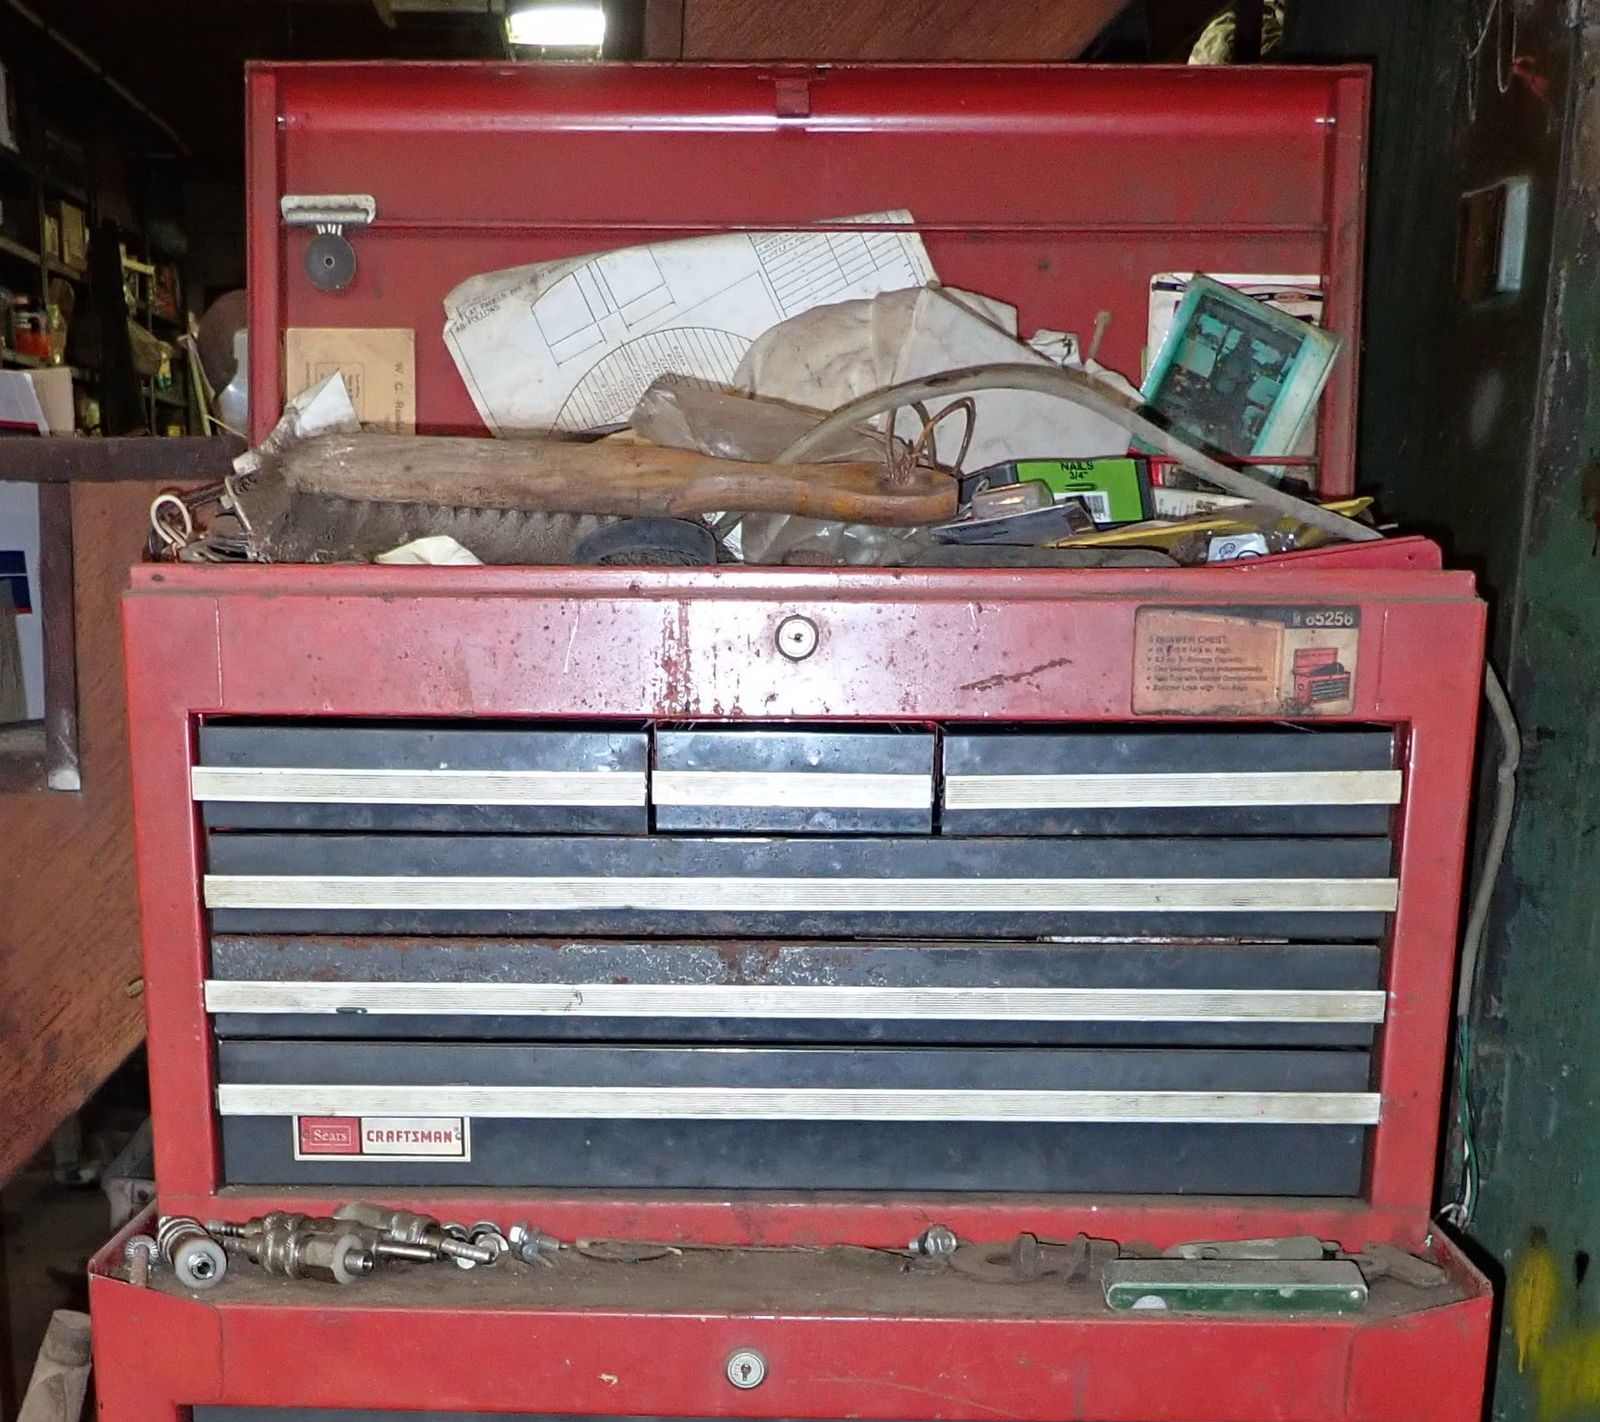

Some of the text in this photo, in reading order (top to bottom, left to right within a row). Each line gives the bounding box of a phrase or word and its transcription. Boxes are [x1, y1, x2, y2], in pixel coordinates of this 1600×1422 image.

[1060, 461, 1094, 470] NAILS
[313, 1129, 452, 1143] Sears CRAFTSMAN
